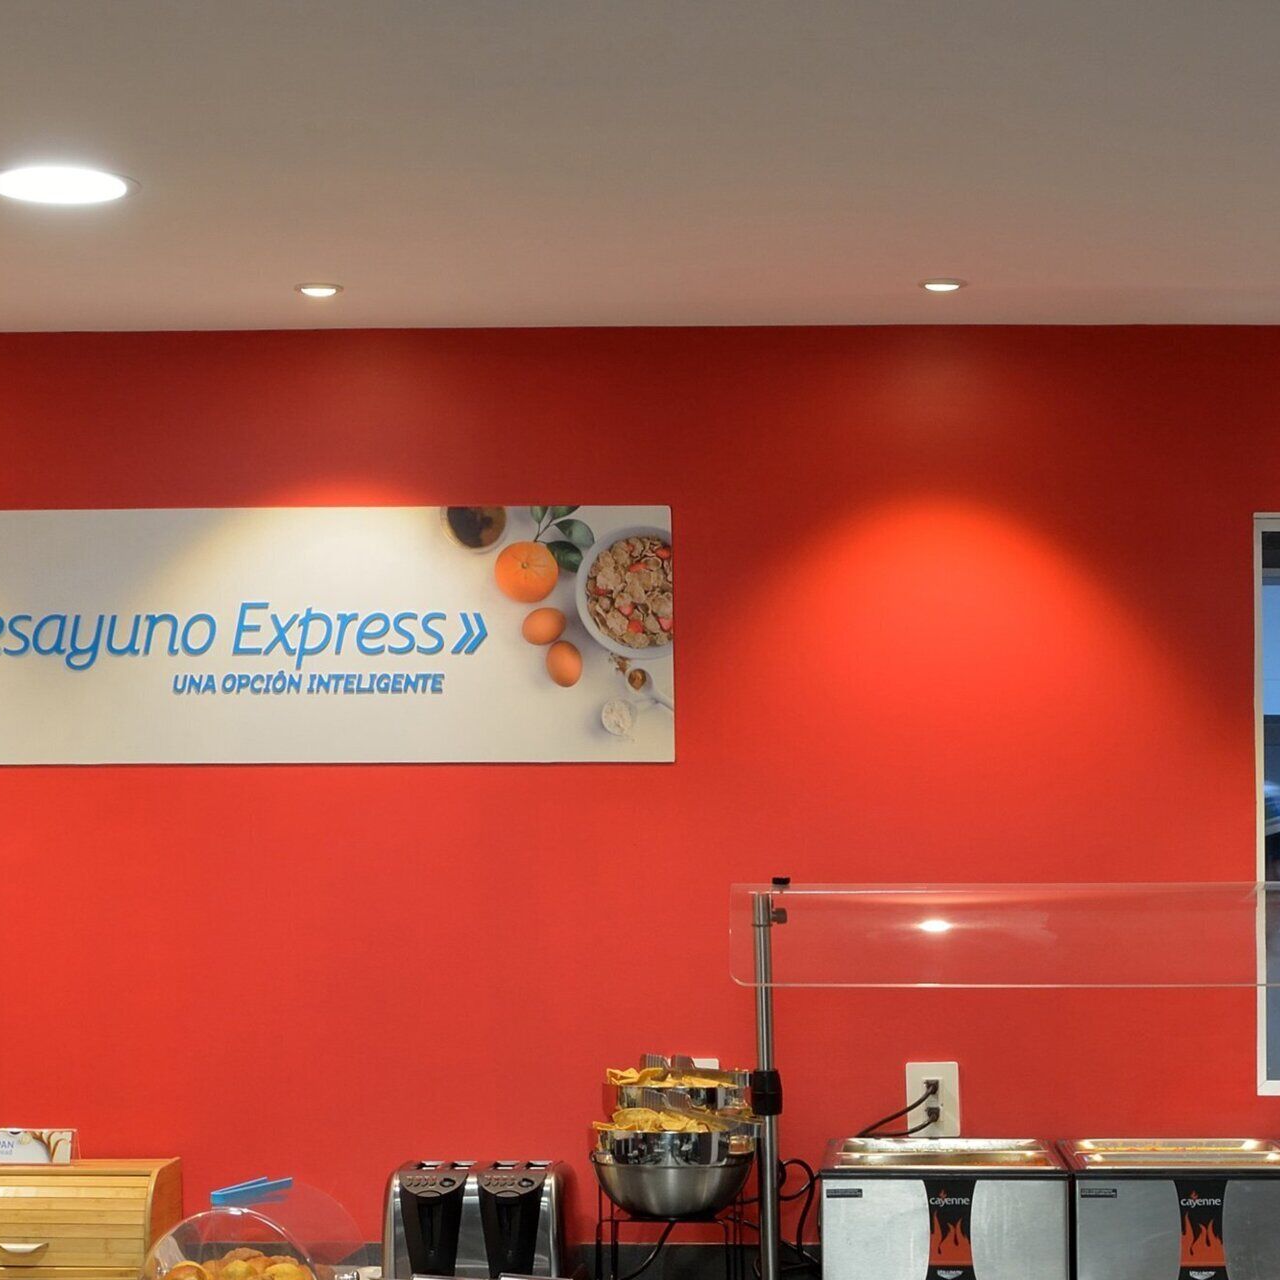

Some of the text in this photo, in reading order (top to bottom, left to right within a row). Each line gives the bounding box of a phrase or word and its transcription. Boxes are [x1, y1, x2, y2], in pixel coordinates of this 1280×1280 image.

[232, 601, 447, 670] Express
[173, 671, 446, 695] UNA OPCIÓN INTELIGENTE
[929, 1196, 970, 1208] cayenne
[1180, 1198, 1222, 1209] cayenne
